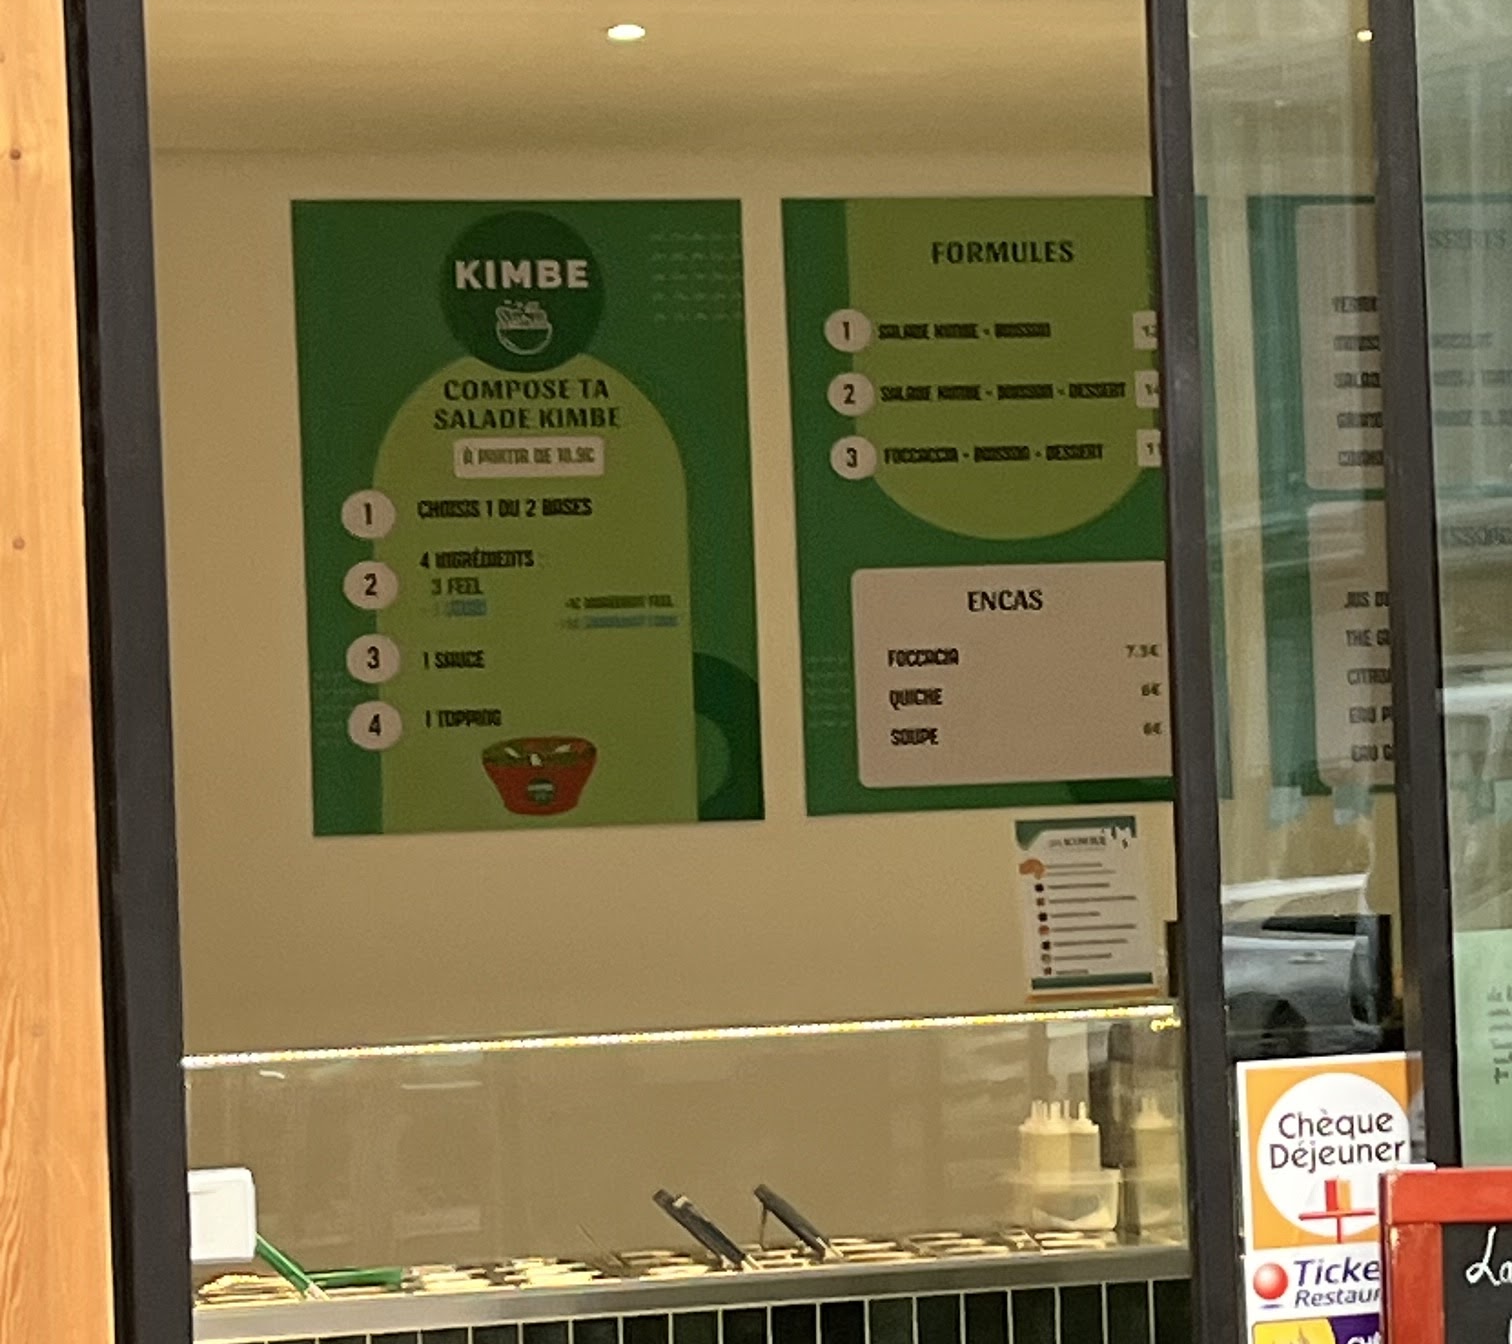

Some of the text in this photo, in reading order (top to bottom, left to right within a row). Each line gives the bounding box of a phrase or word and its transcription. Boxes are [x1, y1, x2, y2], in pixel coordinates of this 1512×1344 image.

[931, 241, 1075, 264] FORMULES
[455, 259, 589, 290] KIMBE
[842, 321, 851, 340] 1
[444, 377, 610, 401] COMPOSE TA
[844, 383, 856, 405] 2
[1068, 382, 1126, 399] DESSERT
[434, 406, 621, 431] SALADE KIMBE
[846, 447, 858, 469] 3
[1046, 443, 1104, 461] DESSERT
[363, 502, 373, 526] 1
[417, 499, 480, 518] CHOISIS
[525, 499, 537, 517] 2
[542, 498, 594, 517] BASES
[420, 546, 535, 569] 4 INGRÉDIENTS
[364, 573, 378, 596] 2
[967, 589, 1044, 612] ENCAS
[366, 646, 381, 670] 3
[434, 650, 486, 669] SAUCE
[889, 687, 943, 711] QUICHE
[368, 713, 382, 737] 4
[438, 708, 503, 728] TOPPING
[890, 727, 940, 746] SOUPE
[1278, 1108, 1394, 1140] Chèque
[1269, 1140, 1406, 1174] Déjeuner
[1293, 1257, 1380, 1288] Ticke
